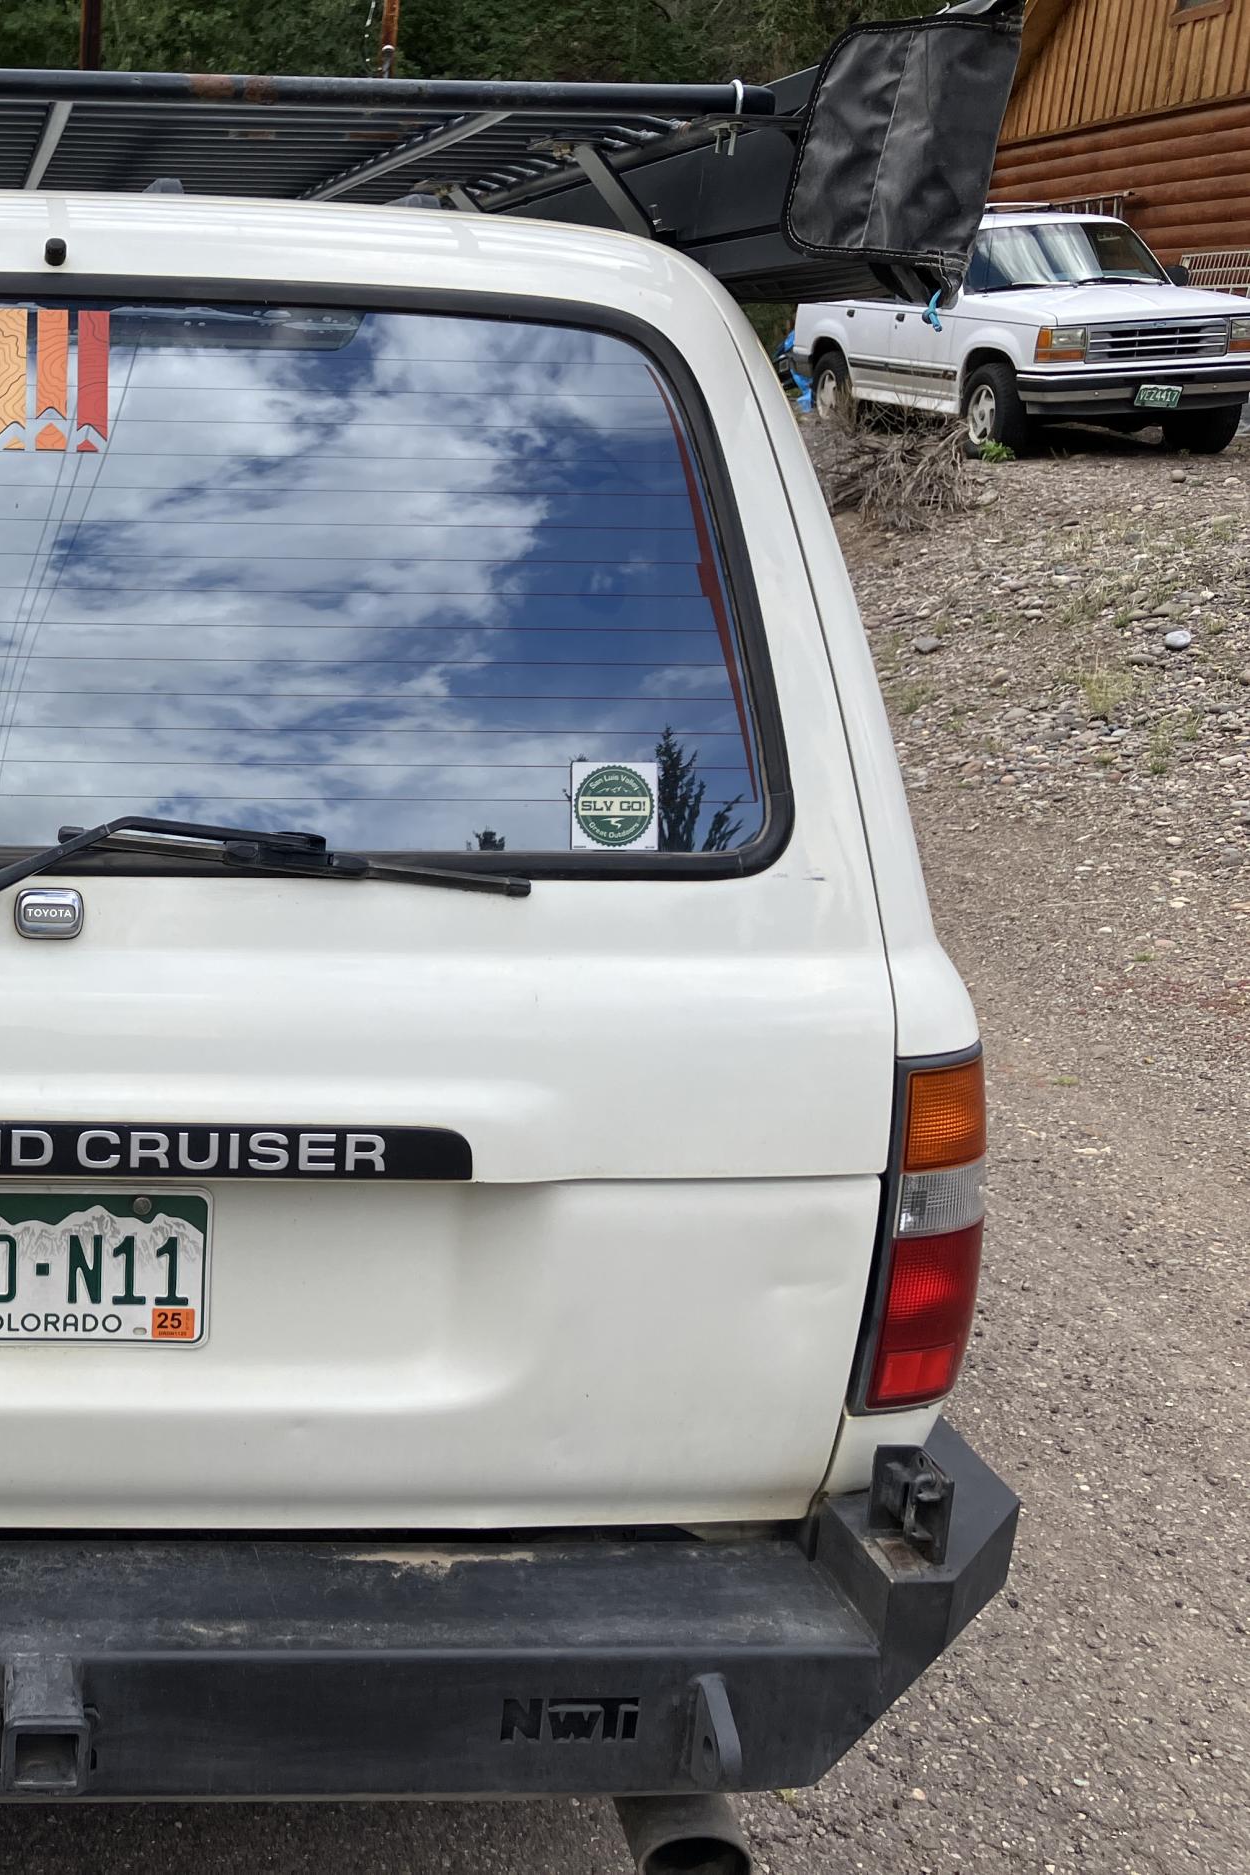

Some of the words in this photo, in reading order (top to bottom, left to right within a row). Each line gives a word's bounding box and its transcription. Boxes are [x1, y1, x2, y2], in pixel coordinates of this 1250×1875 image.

[589, 778, 603, 789] San
[621, 775, 640, 791] Valley
[581, 800, 614, 812] SLV
[619, 800, 646, 812] GO!
[588, 821, 608, 838] Great
[608, 822, 640, 839] Outdoors
[27, 908, 72, 918] TOYOTA
[76, 1129, 387, 1172] CRUISER
[156, 1311, 182, 1329] 25
